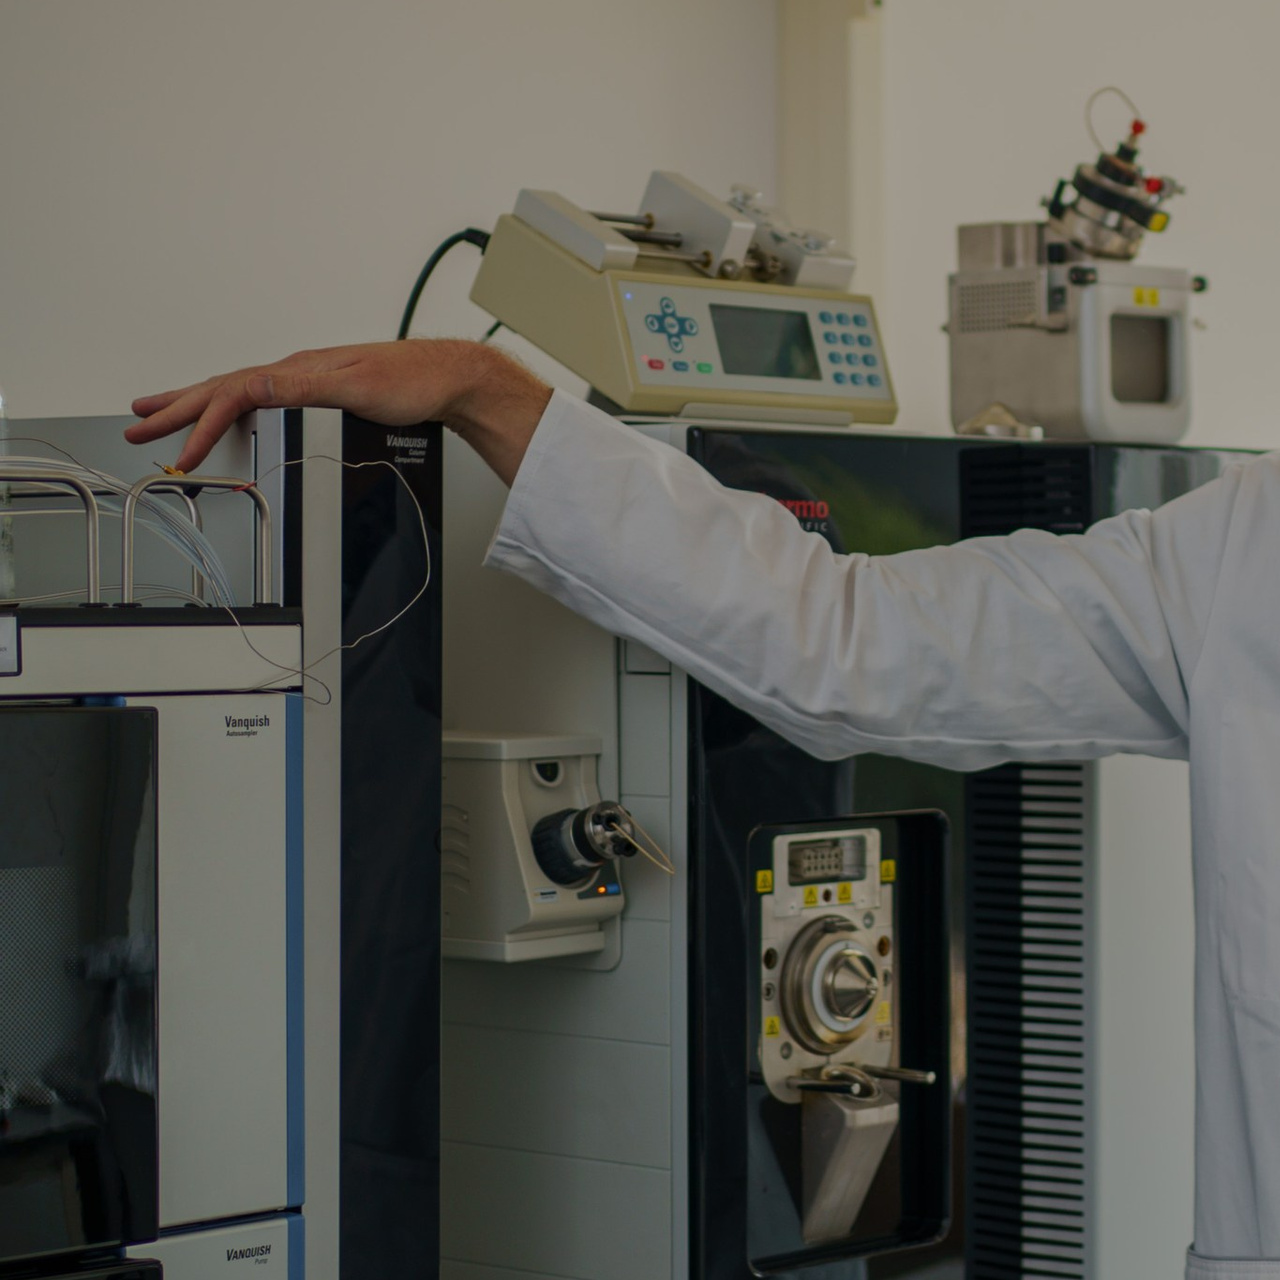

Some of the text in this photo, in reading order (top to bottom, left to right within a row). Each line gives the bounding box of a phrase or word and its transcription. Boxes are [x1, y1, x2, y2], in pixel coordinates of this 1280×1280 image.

[386, 434, 428, 449] VANQUISH
[224, 714, 270, 730] Vanquish
[226, 1244, 271, 1261] VANQUISH
